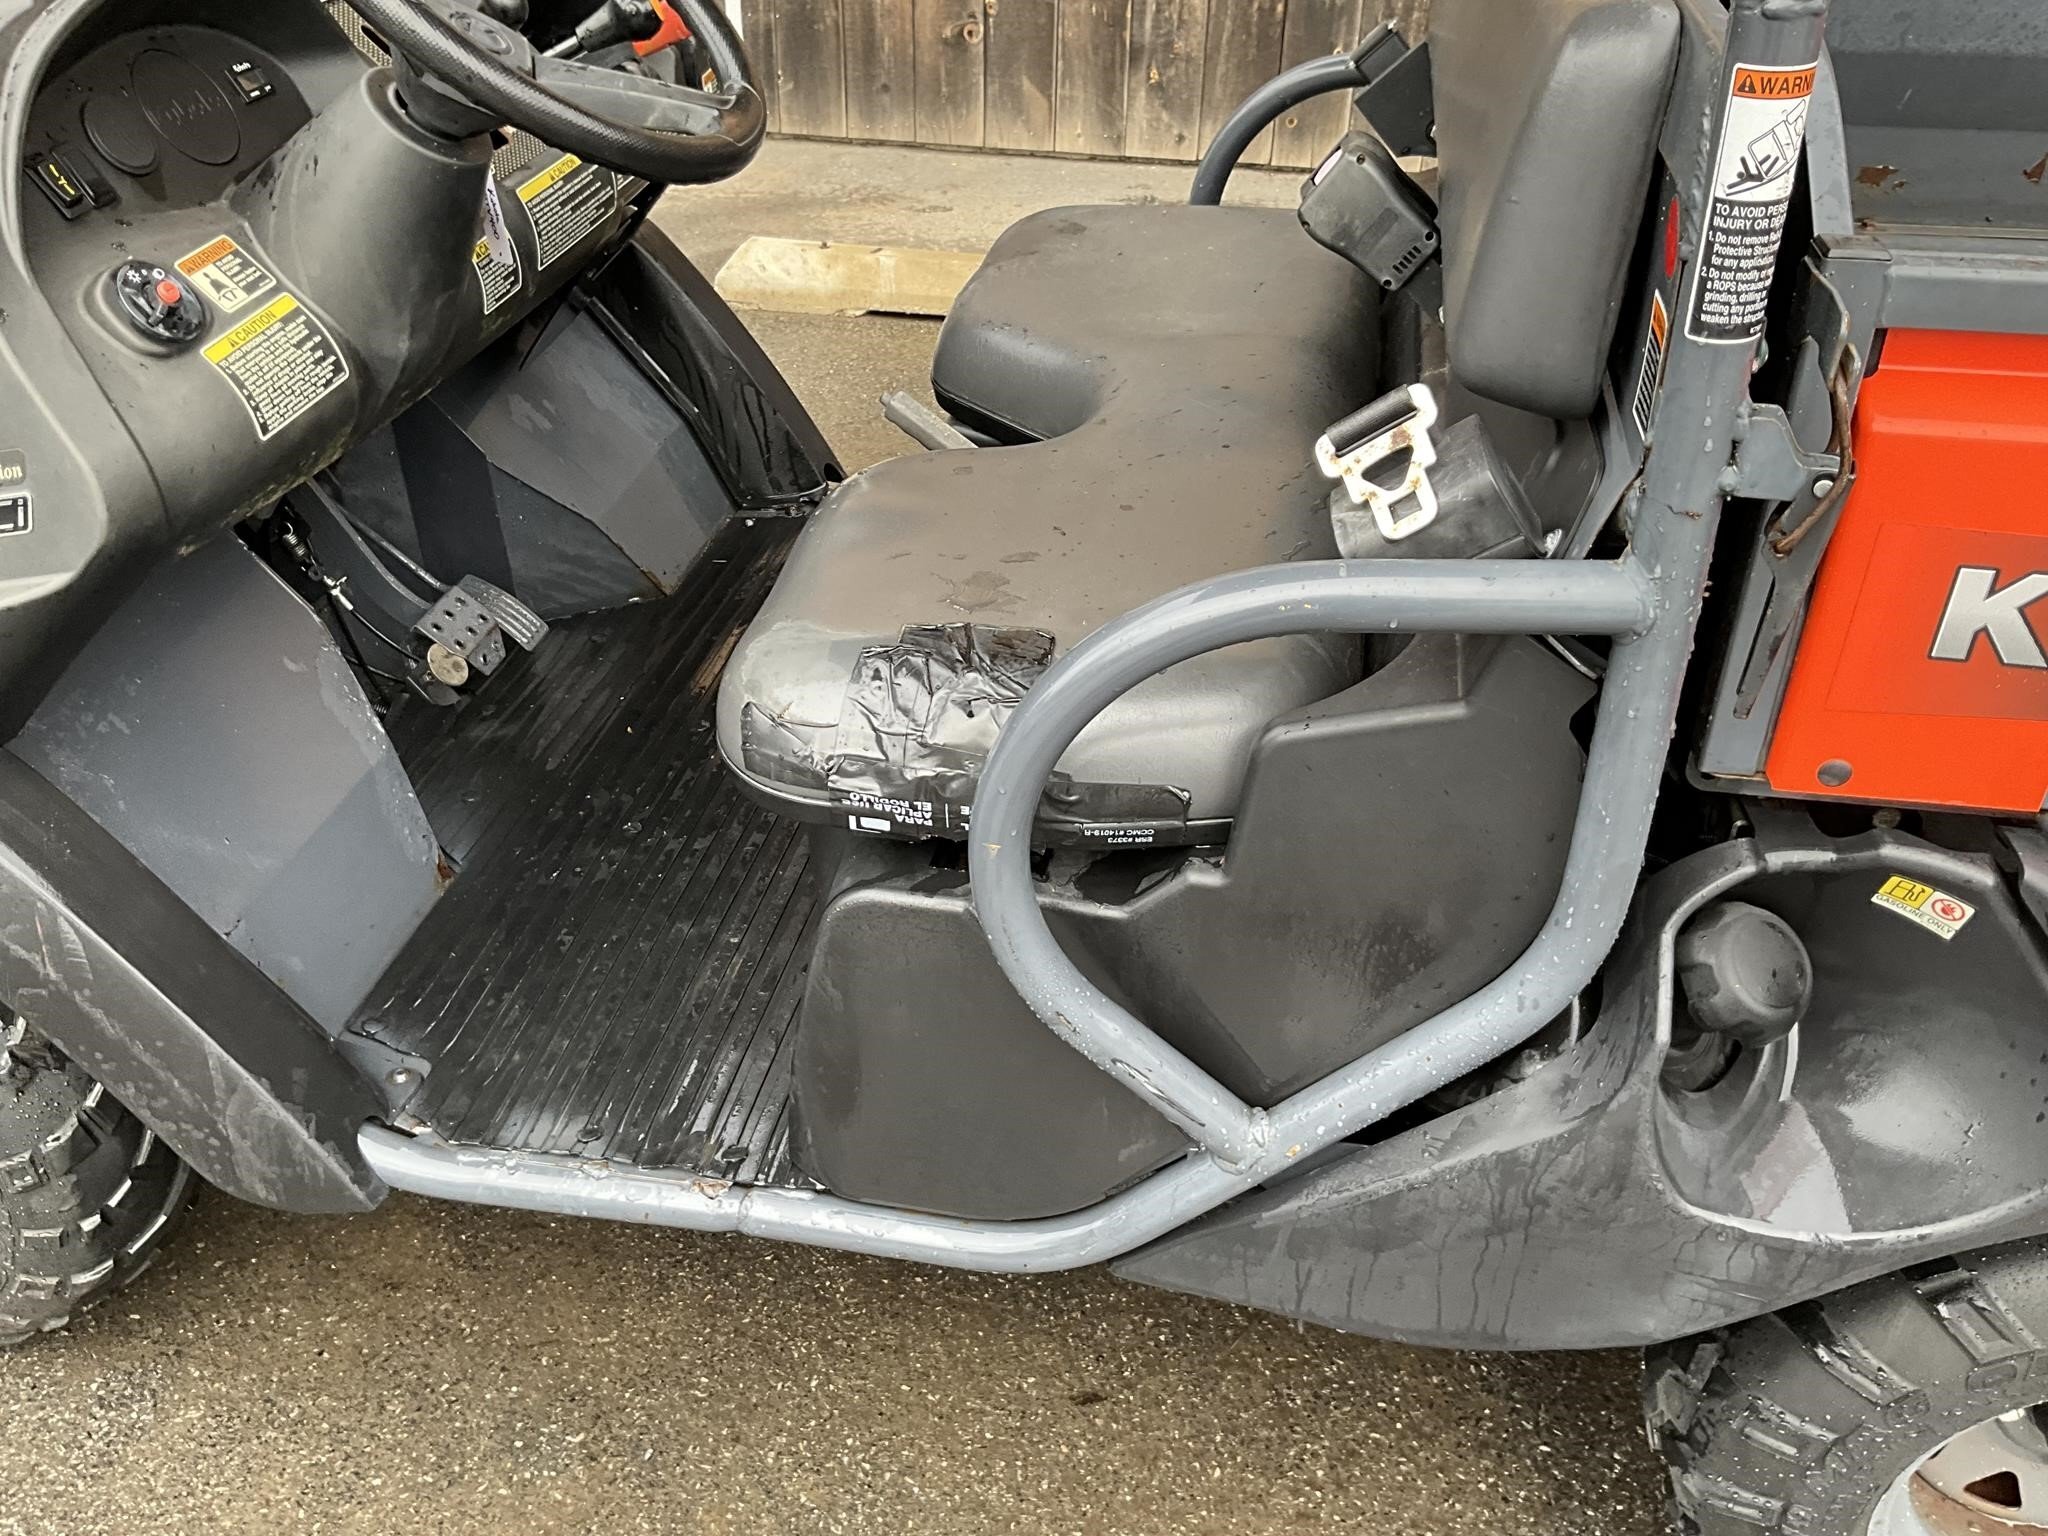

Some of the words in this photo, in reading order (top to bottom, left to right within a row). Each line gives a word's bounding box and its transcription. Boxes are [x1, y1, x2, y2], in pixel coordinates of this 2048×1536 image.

[1716, 203, 1729, 215] TO
[1732, 206, 1766, 217] AVOID
[1713, 216, 1753, 229] INJURY
[1754, 219, 1769, 229] OR
[1716, 232, 1726, 242] Do
[1728, 235, 1741, 246] not
[191, 240, 233, 269] WARNING
[1714, 245, 1752, 256] Protective
[1712, 255, 1722, 265] for
[1724, 258, 1738, 269] any
[1709, 268, 1719, 278] Do
[1721, 270, 1734, 280] not
[1713, 280, 1736, 291] ROPS
[1702, 301, 1729, 314] cutting
[1730, 303, 1744, 315] any
[1701, 313, 1729, 324] weaken
[1730, 314, 1742, 324] the
[236, 310, 278, 342] CAUTION
[849, 791, 909, 808] RODILLO
[913, 801, 933, 812] EL
[873, 802, 933, 820] APLICAR
[894, 813, 933, 827] PARA
[1875, 894, 1923, 918] GASOLINE
[1927, 917, 1953, 935] ONLY
